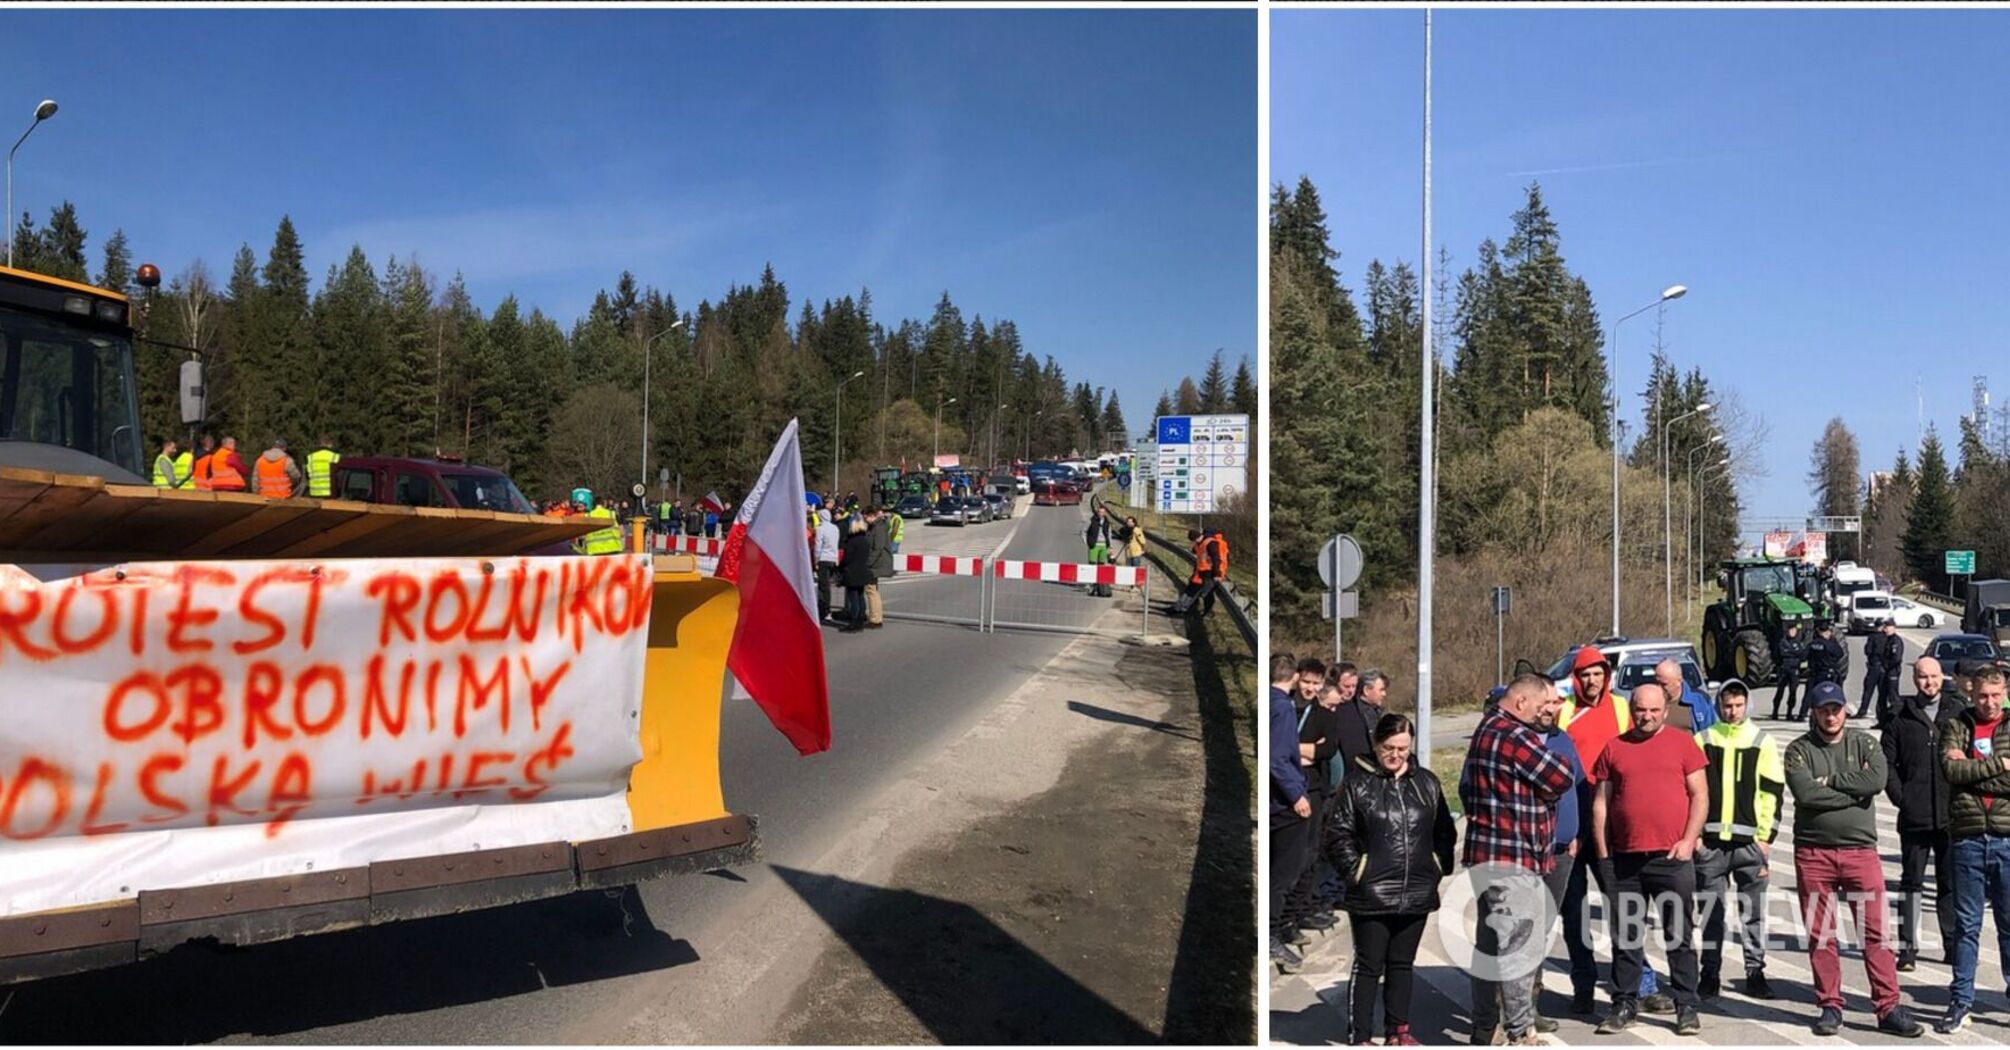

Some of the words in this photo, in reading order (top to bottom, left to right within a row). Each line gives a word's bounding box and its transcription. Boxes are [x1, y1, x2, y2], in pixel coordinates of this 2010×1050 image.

[0, 566, 348, 661] ROTEST
[103, 653, 571, 749] OBRONIMY
[0, 752, 311, 839] OLSKĄ
